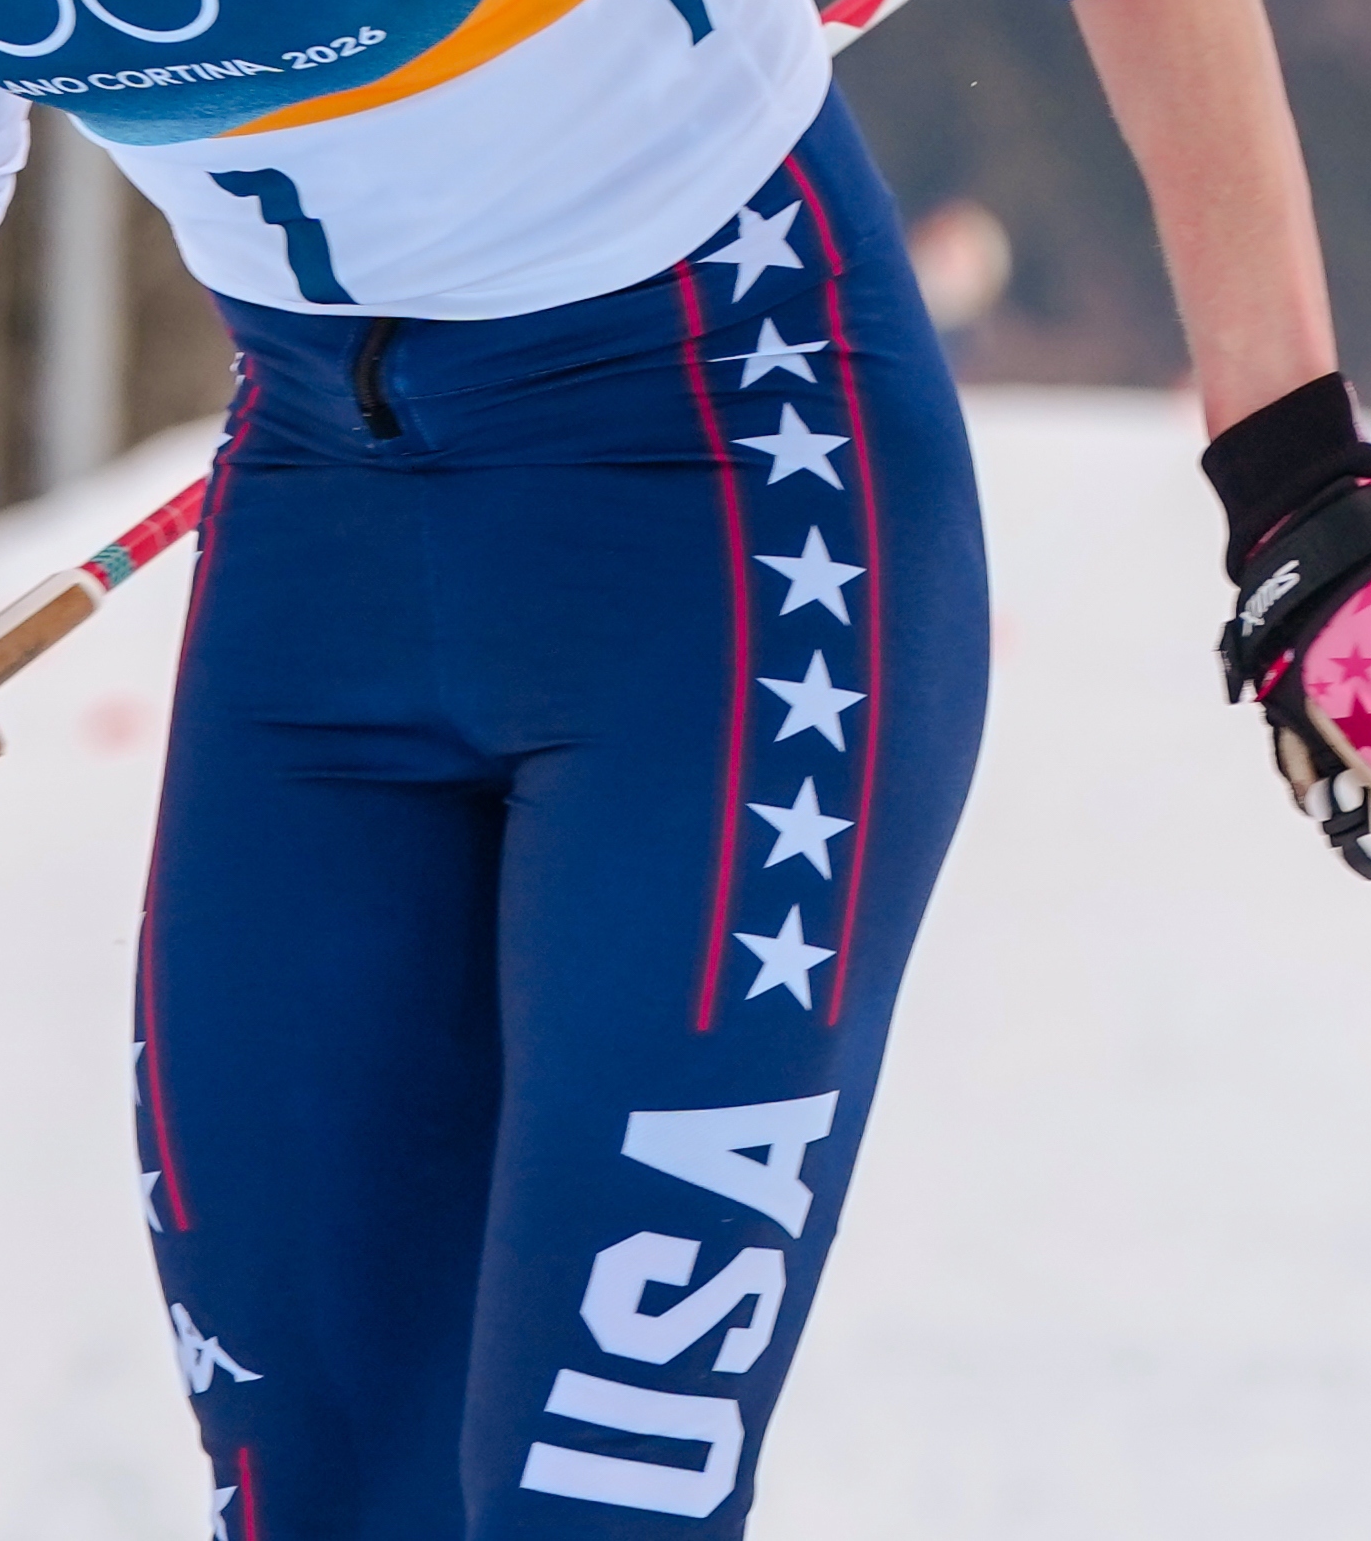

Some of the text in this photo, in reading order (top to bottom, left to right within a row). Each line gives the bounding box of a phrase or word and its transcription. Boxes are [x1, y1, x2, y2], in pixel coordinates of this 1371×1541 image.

[87, 58, 284, 92] CORTINA
[281, 25, 387, 70] 2026
[207, 167, 361, 305] 1
[519, 1089, 841, 1519] USA
